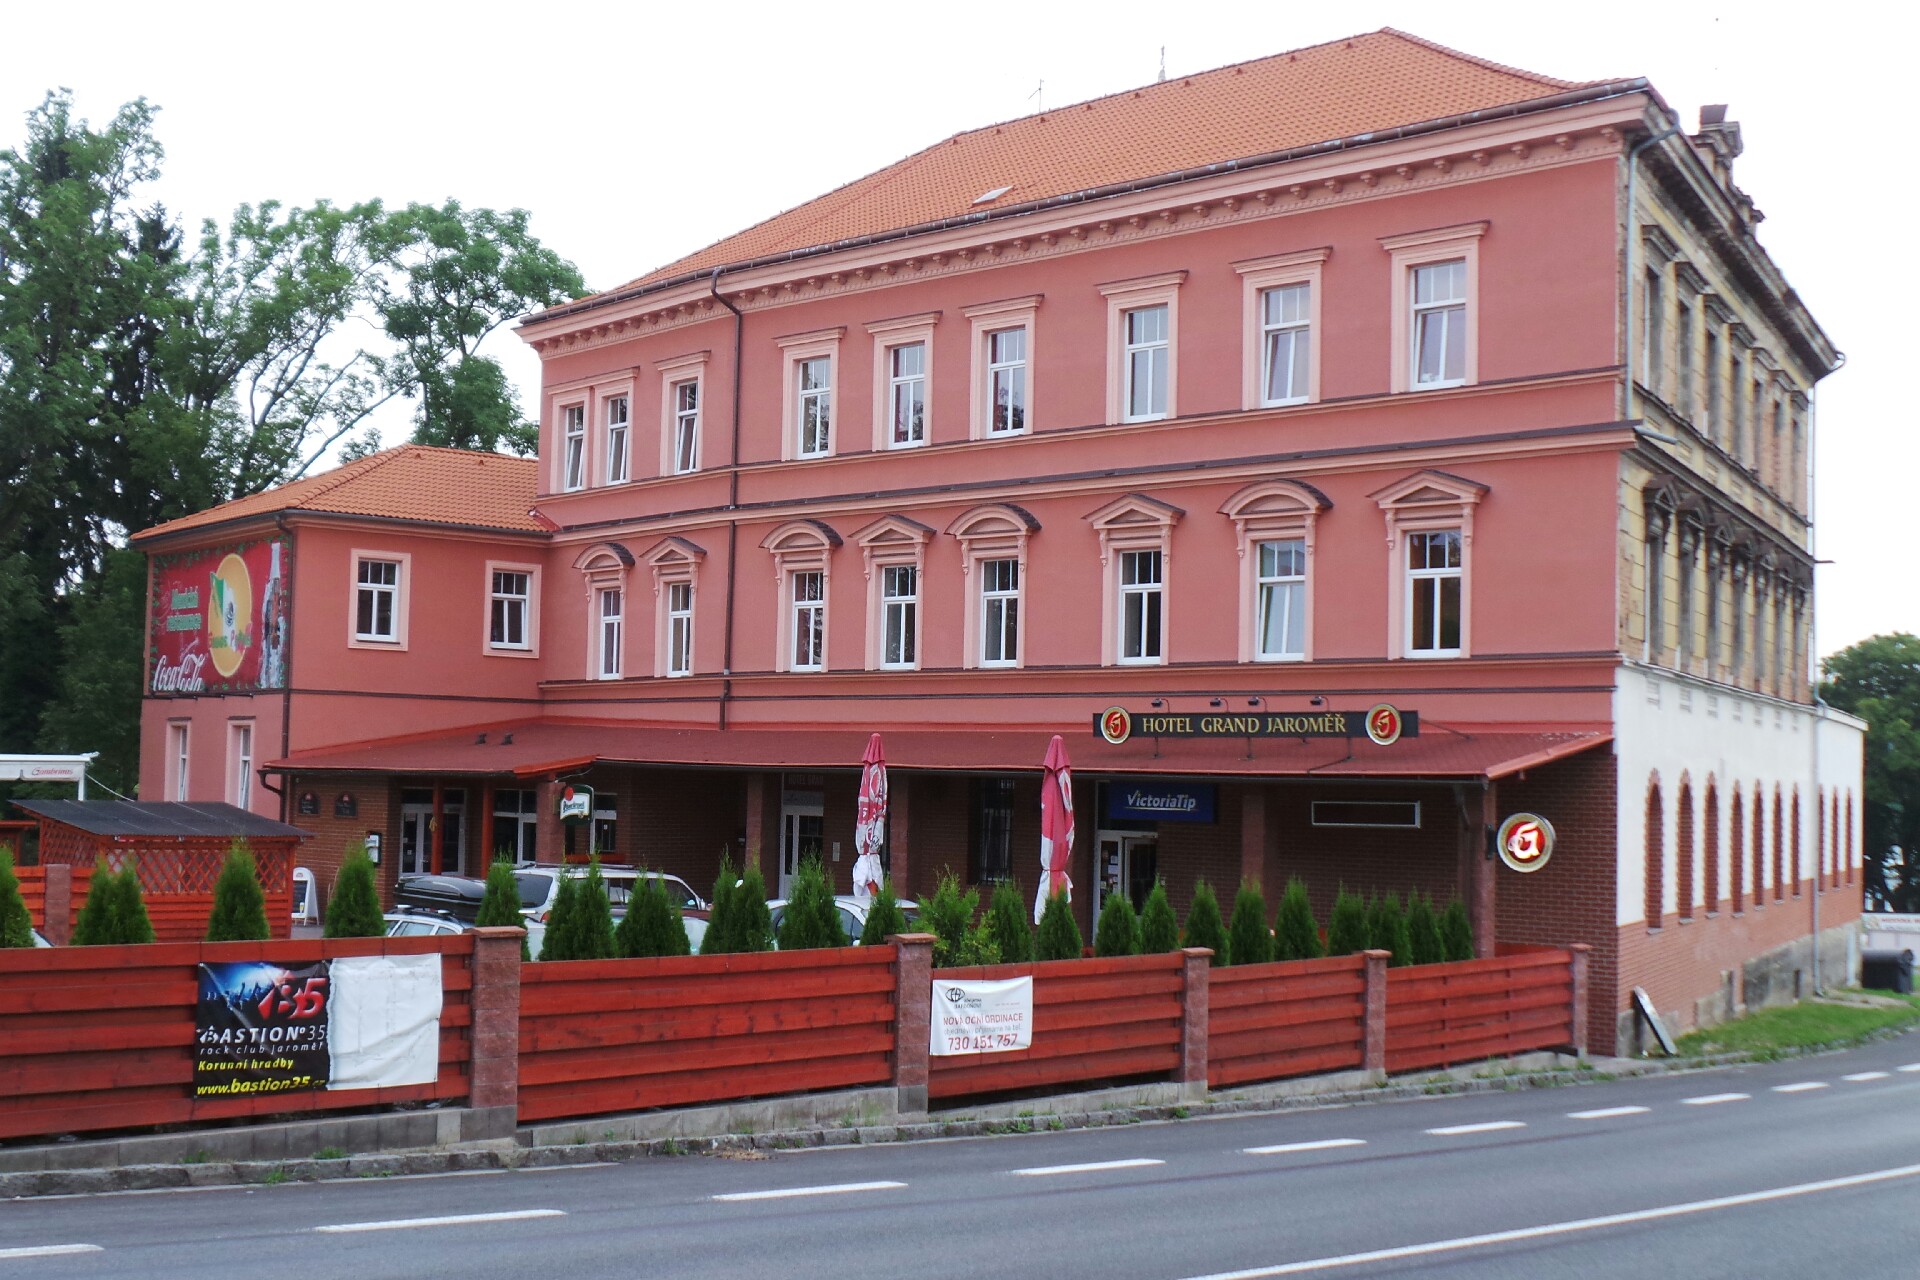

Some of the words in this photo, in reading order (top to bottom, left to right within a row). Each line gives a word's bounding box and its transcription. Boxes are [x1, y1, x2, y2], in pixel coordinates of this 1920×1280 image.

[1142, 717, 1194, 733] HOTEL
[1200, 717, 1260, 733] GRAND
[1266, 713, 1346, 733] JAROMĚŘ
[1127, 790, 1196, 812] VictoriaTip
[985, 1012, 1023, 1024] ORDINACE
[307, 1024, 326, 1041] 35
[200, 1046, 229, 1055] rock
[236, 1044, 265, 1054] club
[948, 1036, 970, 1051] 730
[973, 1034, 993, 1049] 151
[997, 1033, 1018, 1048] 757
[198, 1060, 247, 1071] Korunní
[251, 1057, 294, 1070] hradby
